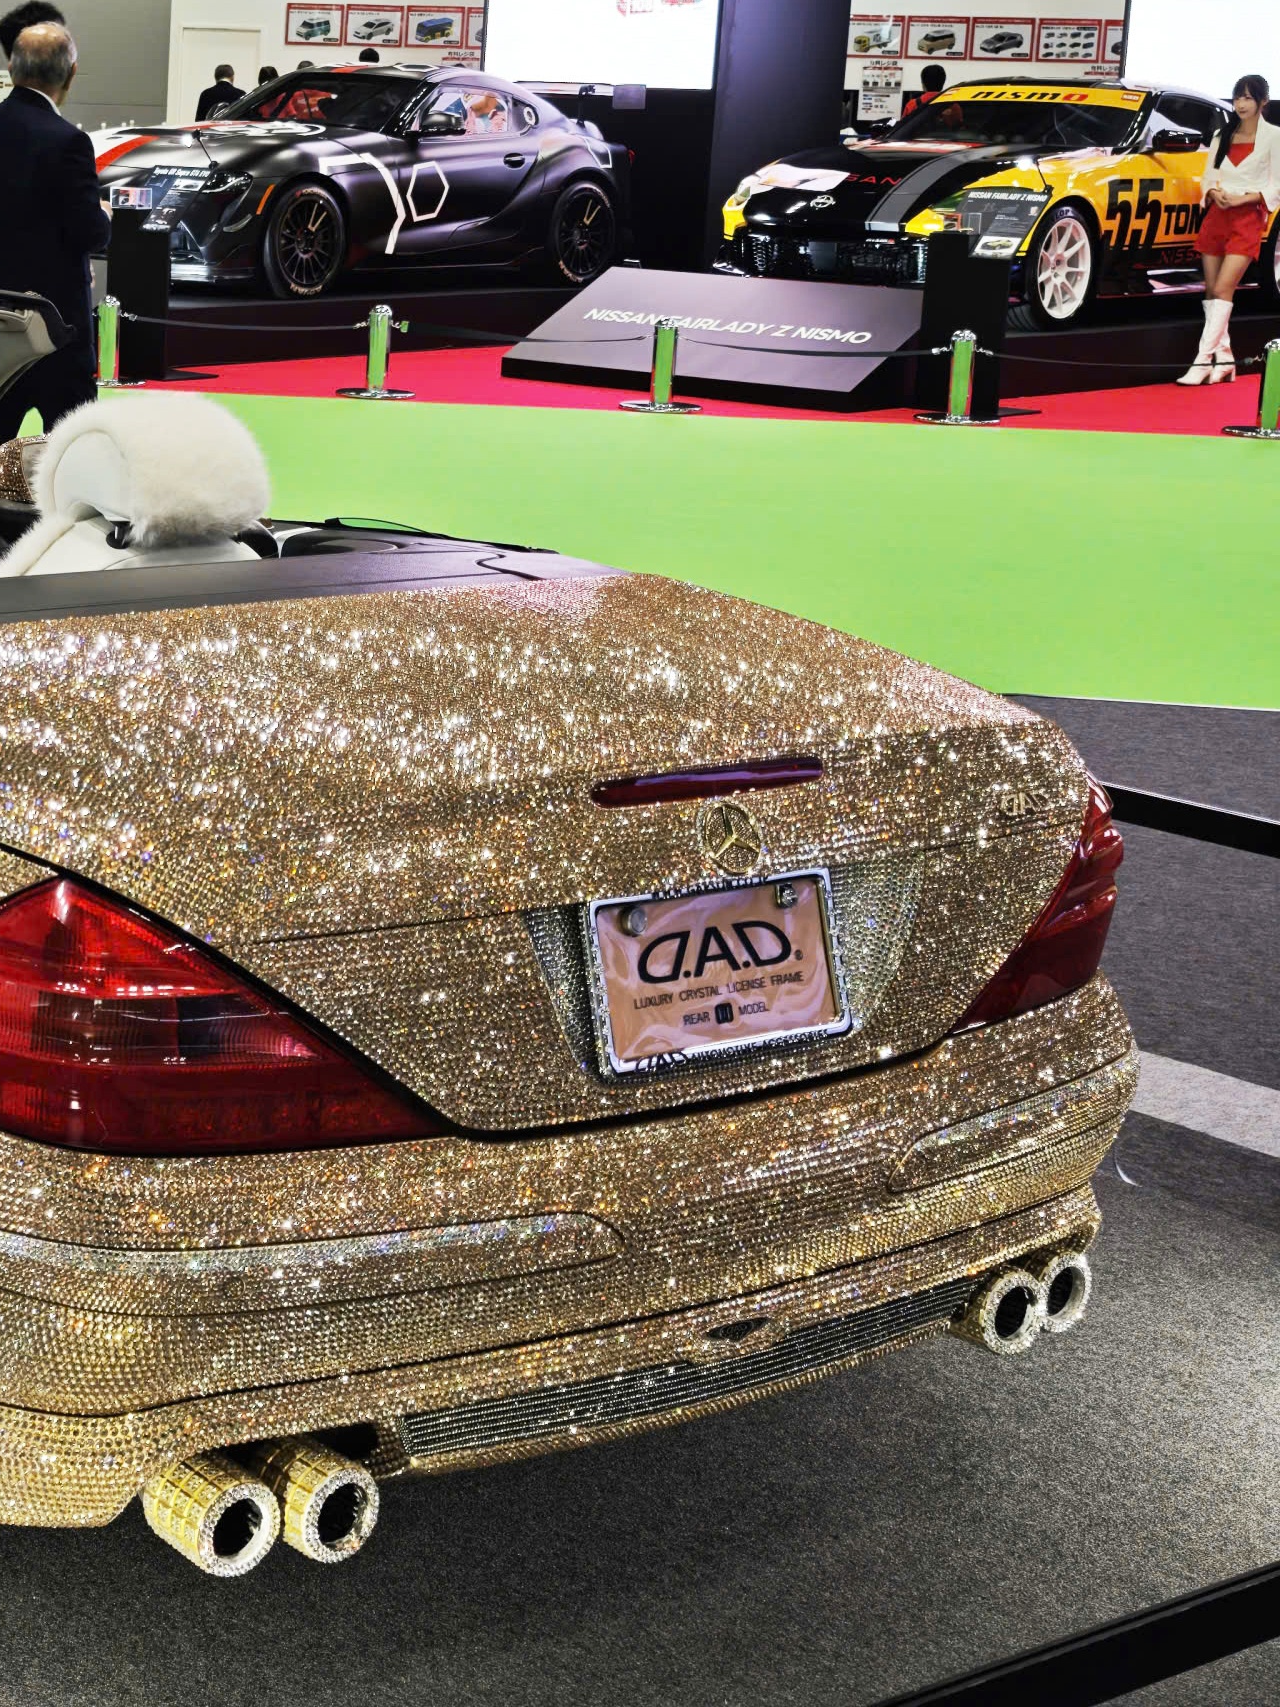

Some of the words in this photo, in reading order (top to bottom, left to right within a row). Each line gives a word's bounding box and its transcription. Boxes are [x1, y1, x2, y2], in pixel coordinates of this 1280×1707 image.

[968, 191, 991, 199] NISSAN
[1103, 178, 1164, 251] 55
[583, 308, 663, 326] NISSAN
[771, 324, 795, 337] Z
[793, 326, 872, 344] NISMO
[633, 993, 674, 1010] LUXURY
[679, 985, 722, 1002] CRYSTAL
[726, 977, 767, 993] LICENSE
[771, 971, 805, 986] FRAME
[683, 1011, 711, 1026] REAR
[738, 1001, 769, 1016] MODEL
